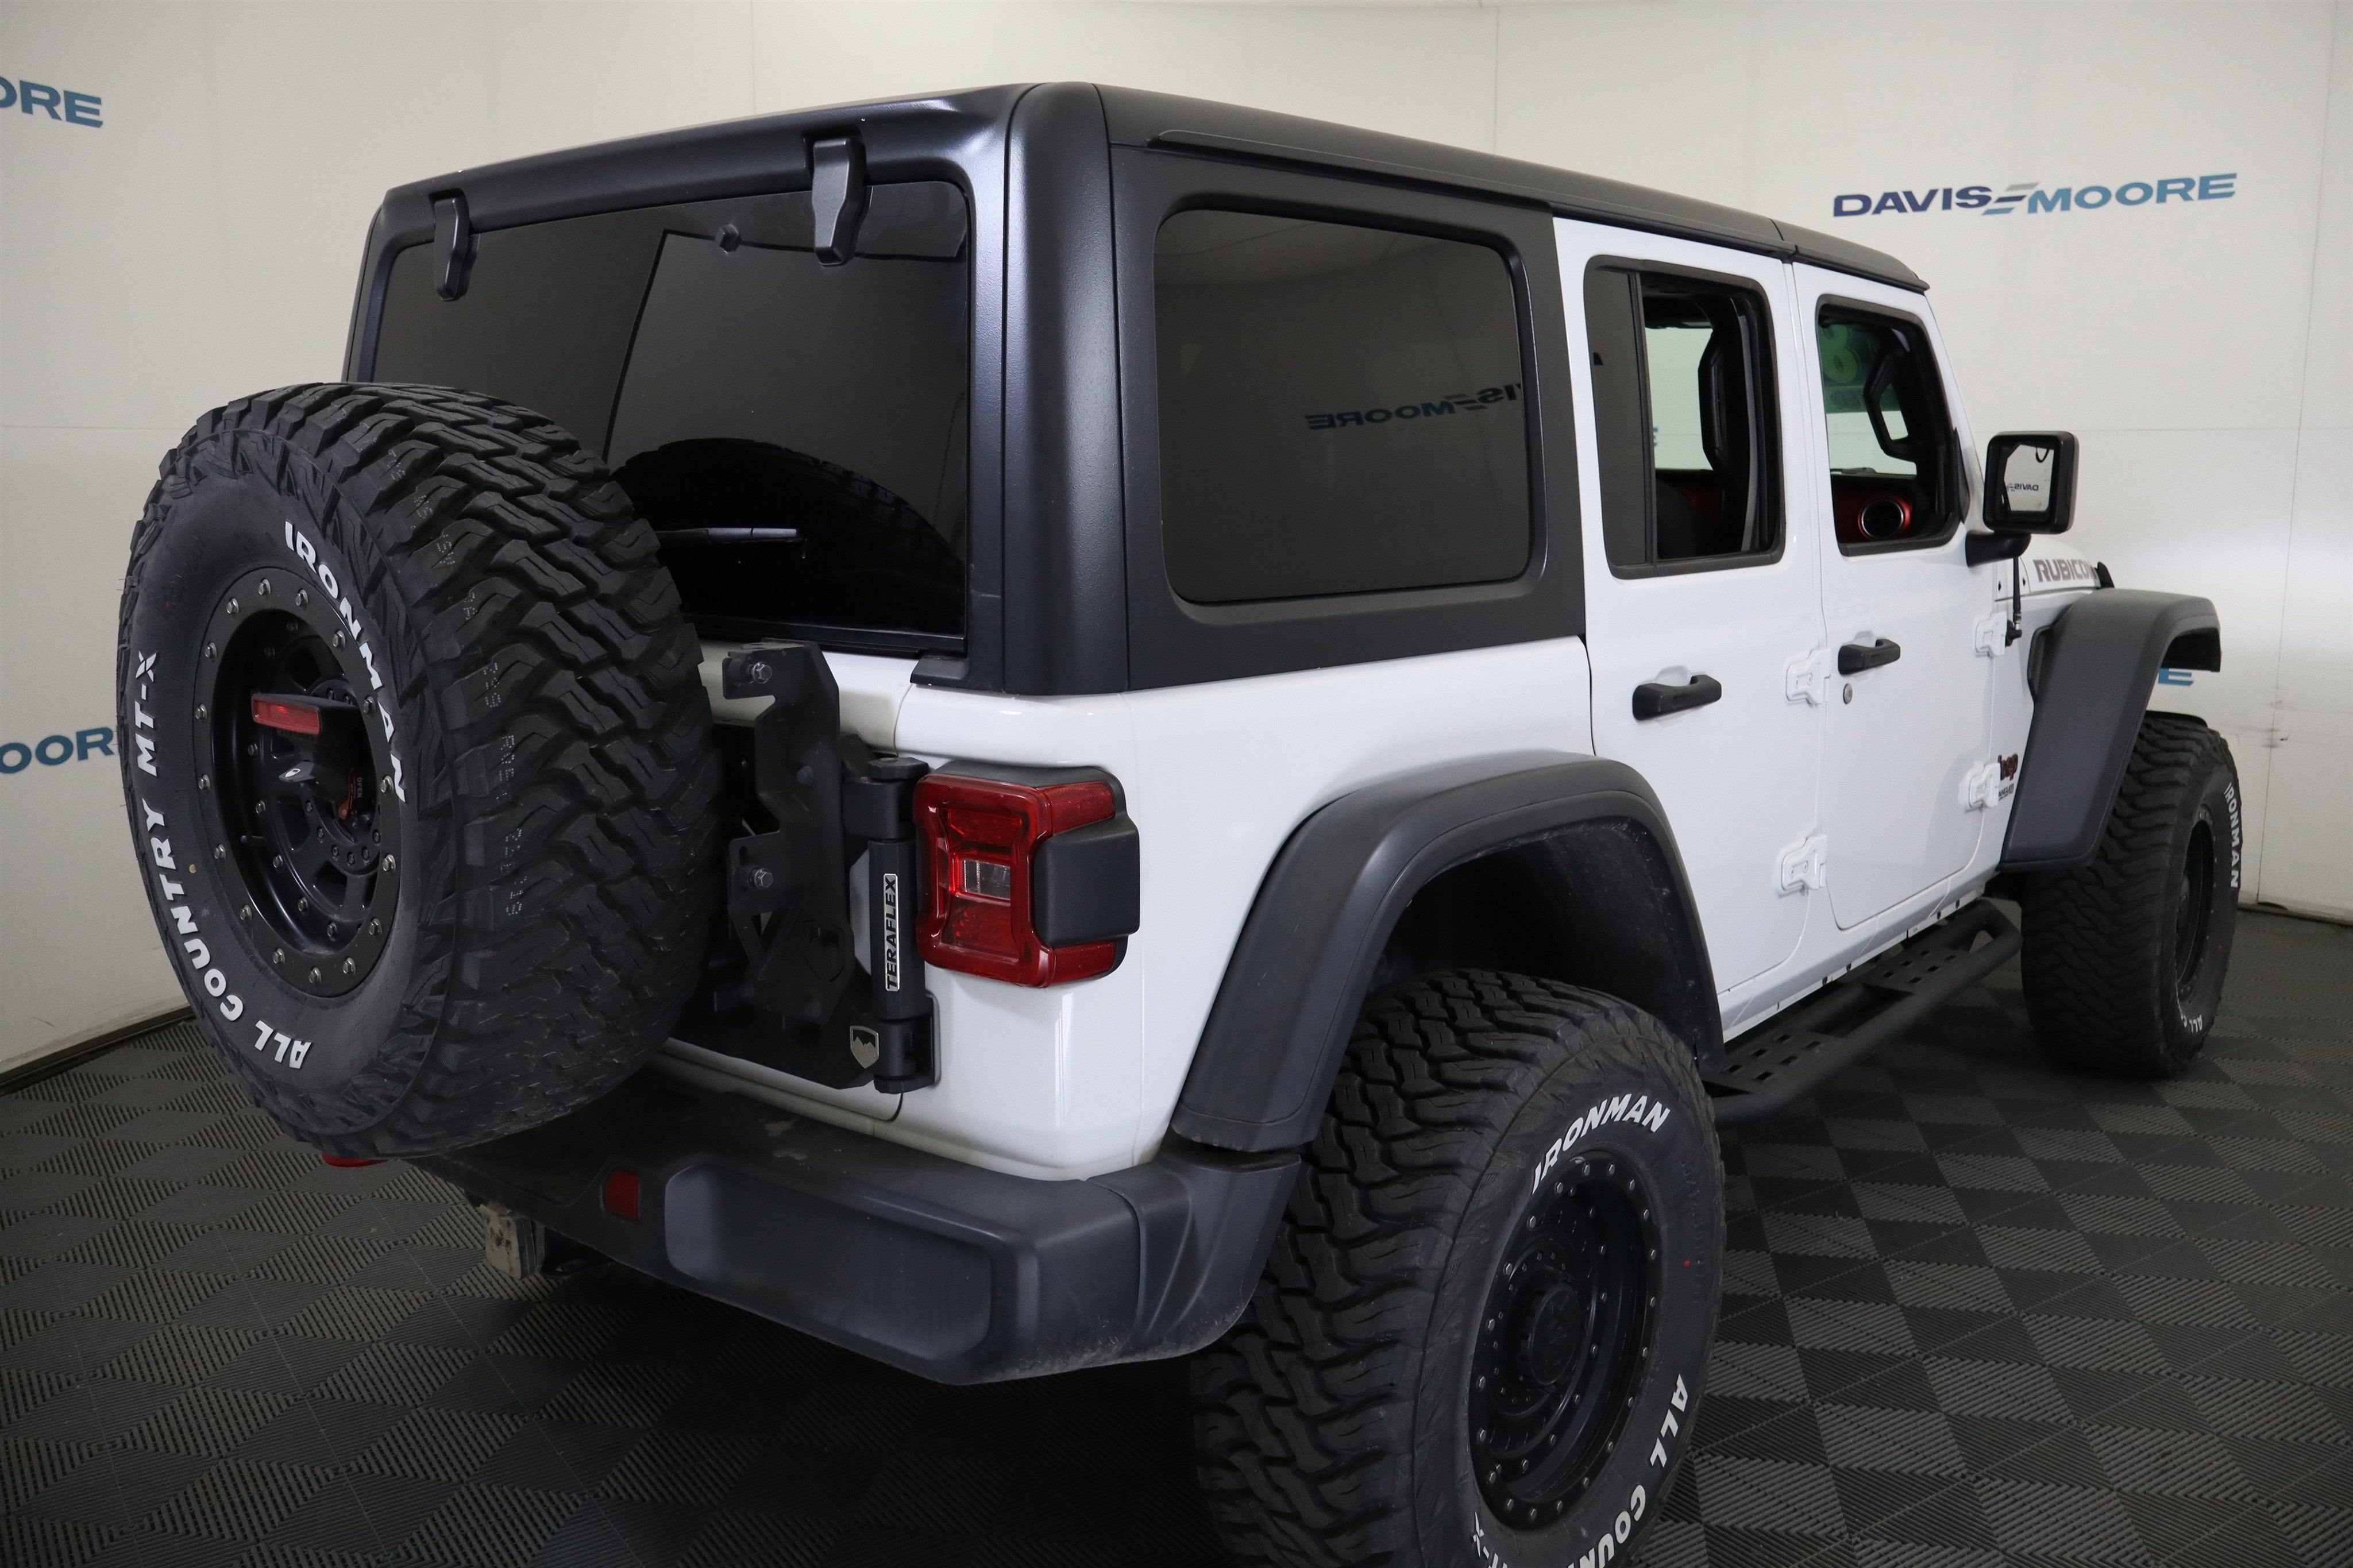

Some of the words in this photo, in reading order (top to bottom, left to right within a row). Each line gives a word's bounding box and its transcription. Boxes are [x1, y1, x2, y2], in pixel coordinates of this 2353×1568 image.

[1833, 186, 1992, 217] DAVIS
[2028, 173, 2236, 213] MOORE
[134, 650, 157, 777] MT-X
[285, 521, 406, 802] IRONMAN
[2224, 782, 2240, 888] IRONMAN
[142, 798, 244, 1021] COUNTRY
[885, 876, 897, 989] TERAFLEX
[255, 1021, 311, 1069] ALL
[1532, 1093, 1671, 1195] IRONMAN
[1650, 1374, 1688, 1468] ALL
